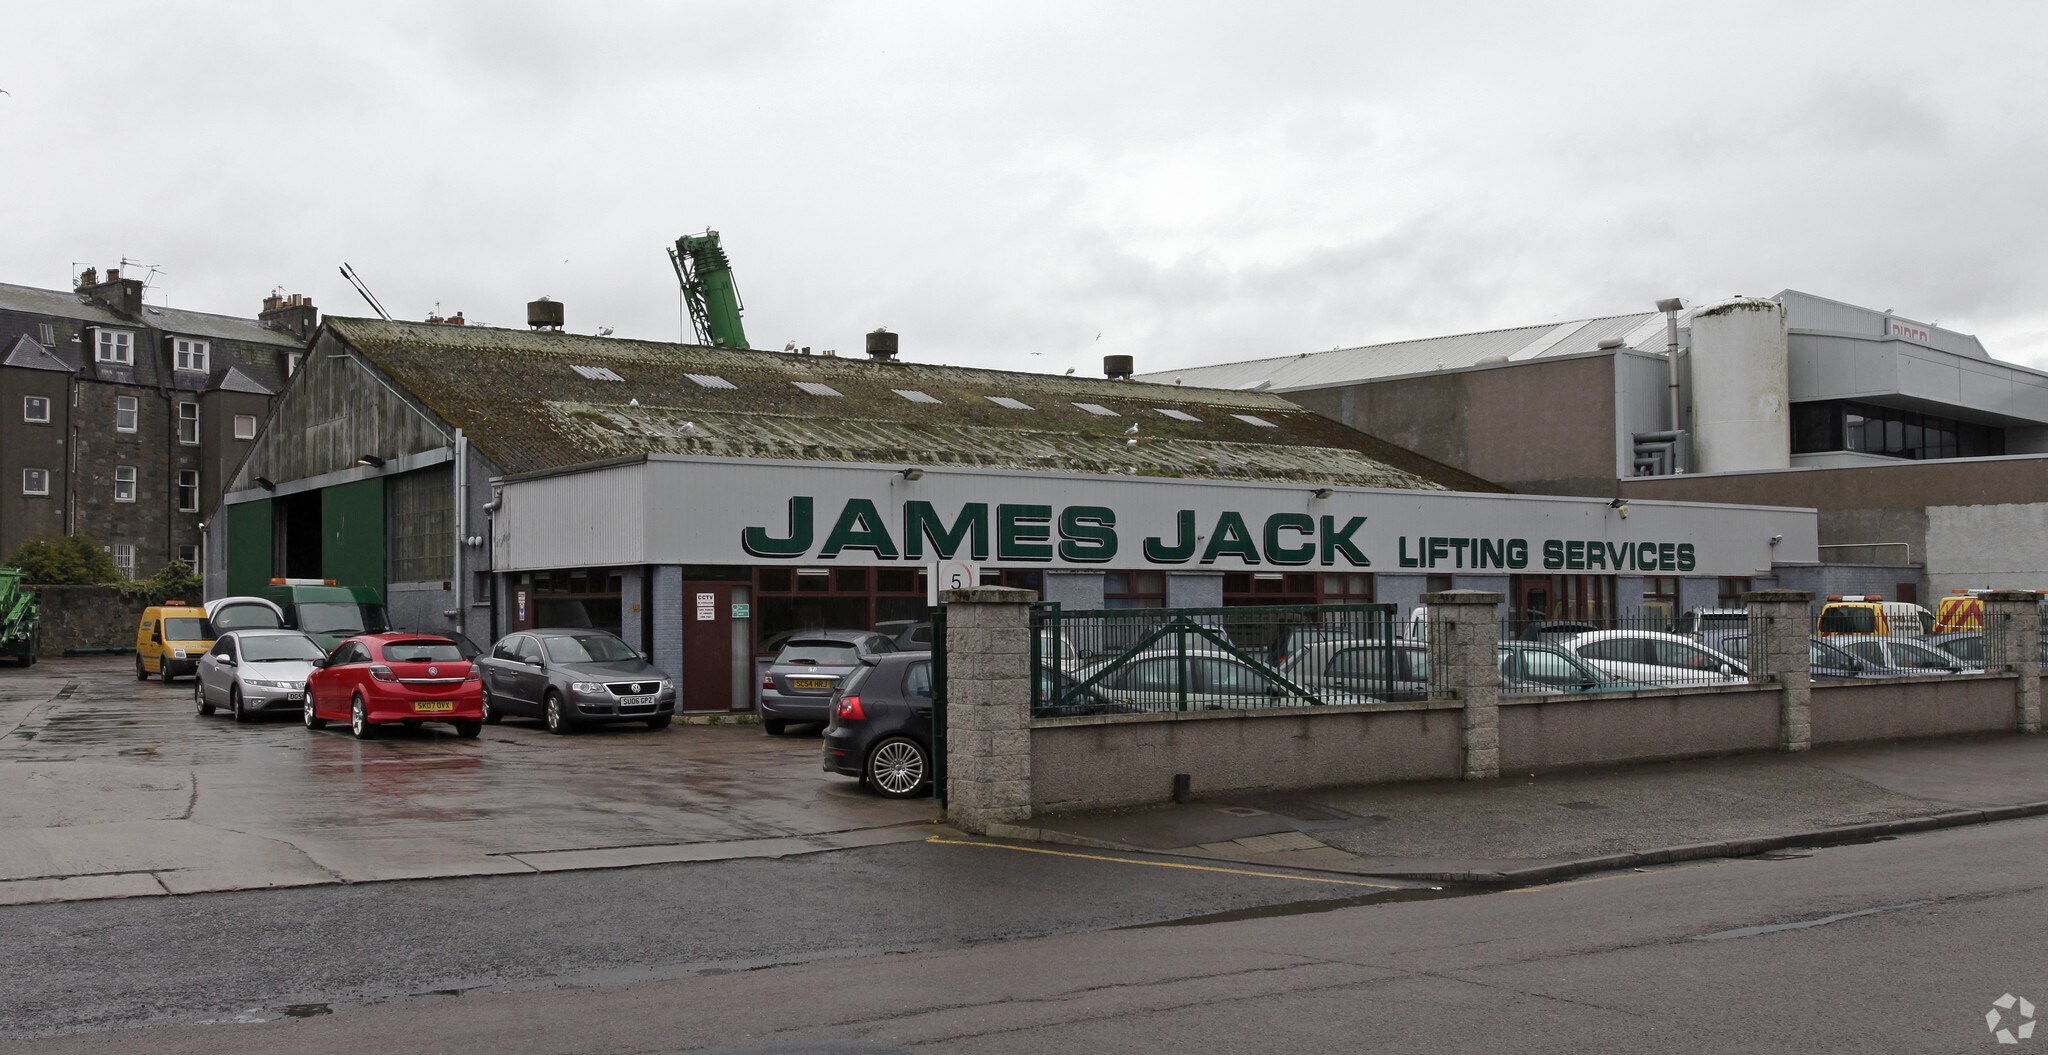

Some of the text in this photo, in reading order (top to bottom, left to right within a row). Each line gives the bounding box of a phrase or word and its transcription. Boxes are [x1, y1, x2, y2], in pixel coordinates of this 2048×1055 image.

[741, 496, 1371, 566] JAMES JACK
[1399, 536, 1696, 571] LIFTING SERVICES
[951, 574, 962, 589] 5
